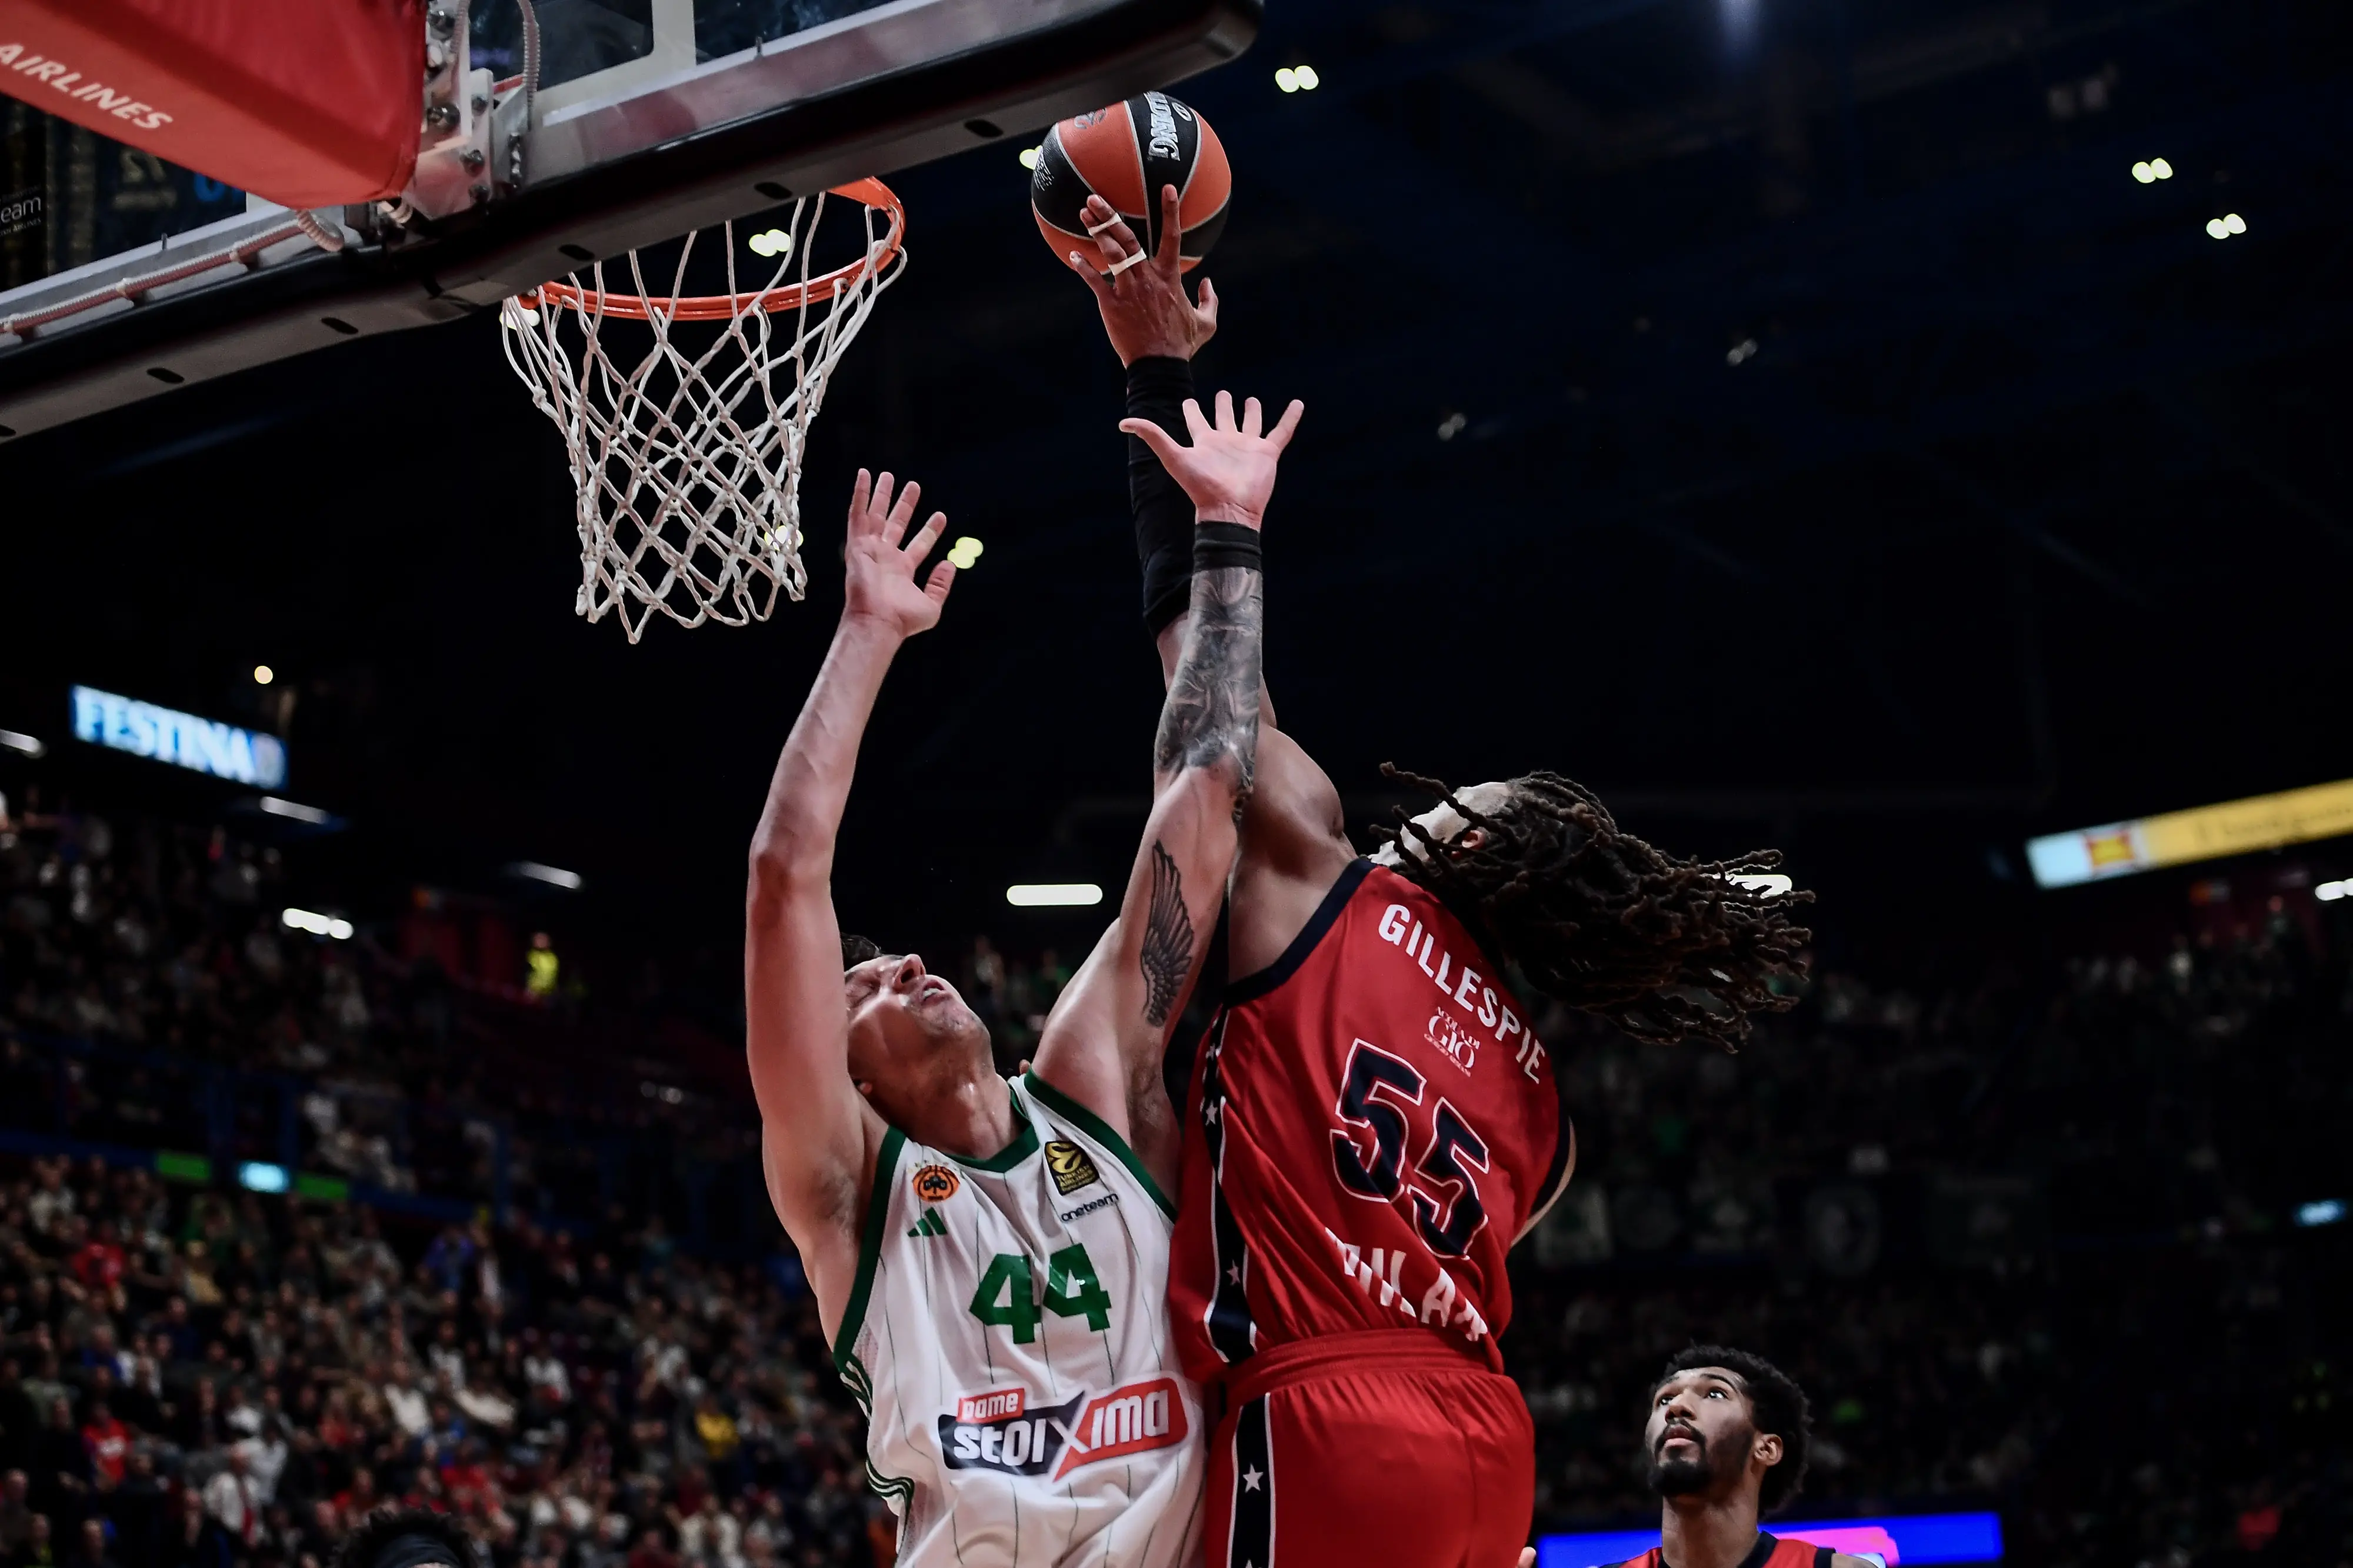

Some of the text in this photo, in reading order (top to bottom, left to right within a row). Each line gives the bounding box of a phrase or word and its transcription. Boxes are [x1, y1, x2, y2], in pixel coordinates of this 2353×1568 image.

[0, 43, 174, 129] AIRLINES
[1143, 89, 1181, 161] LDING
[0, 196, 41, 223] eam
[75, 686, 255, 783] FESTINA
[1378, 904, 1545, 1085] GILLESPIE
[1330, 1037, 1490, 1261] 55
[1061, 1193, 1119, 1222] oneteam
[969, 1244, 1111, 1343] 44
[961, 1392, 1019, 1421] pame
